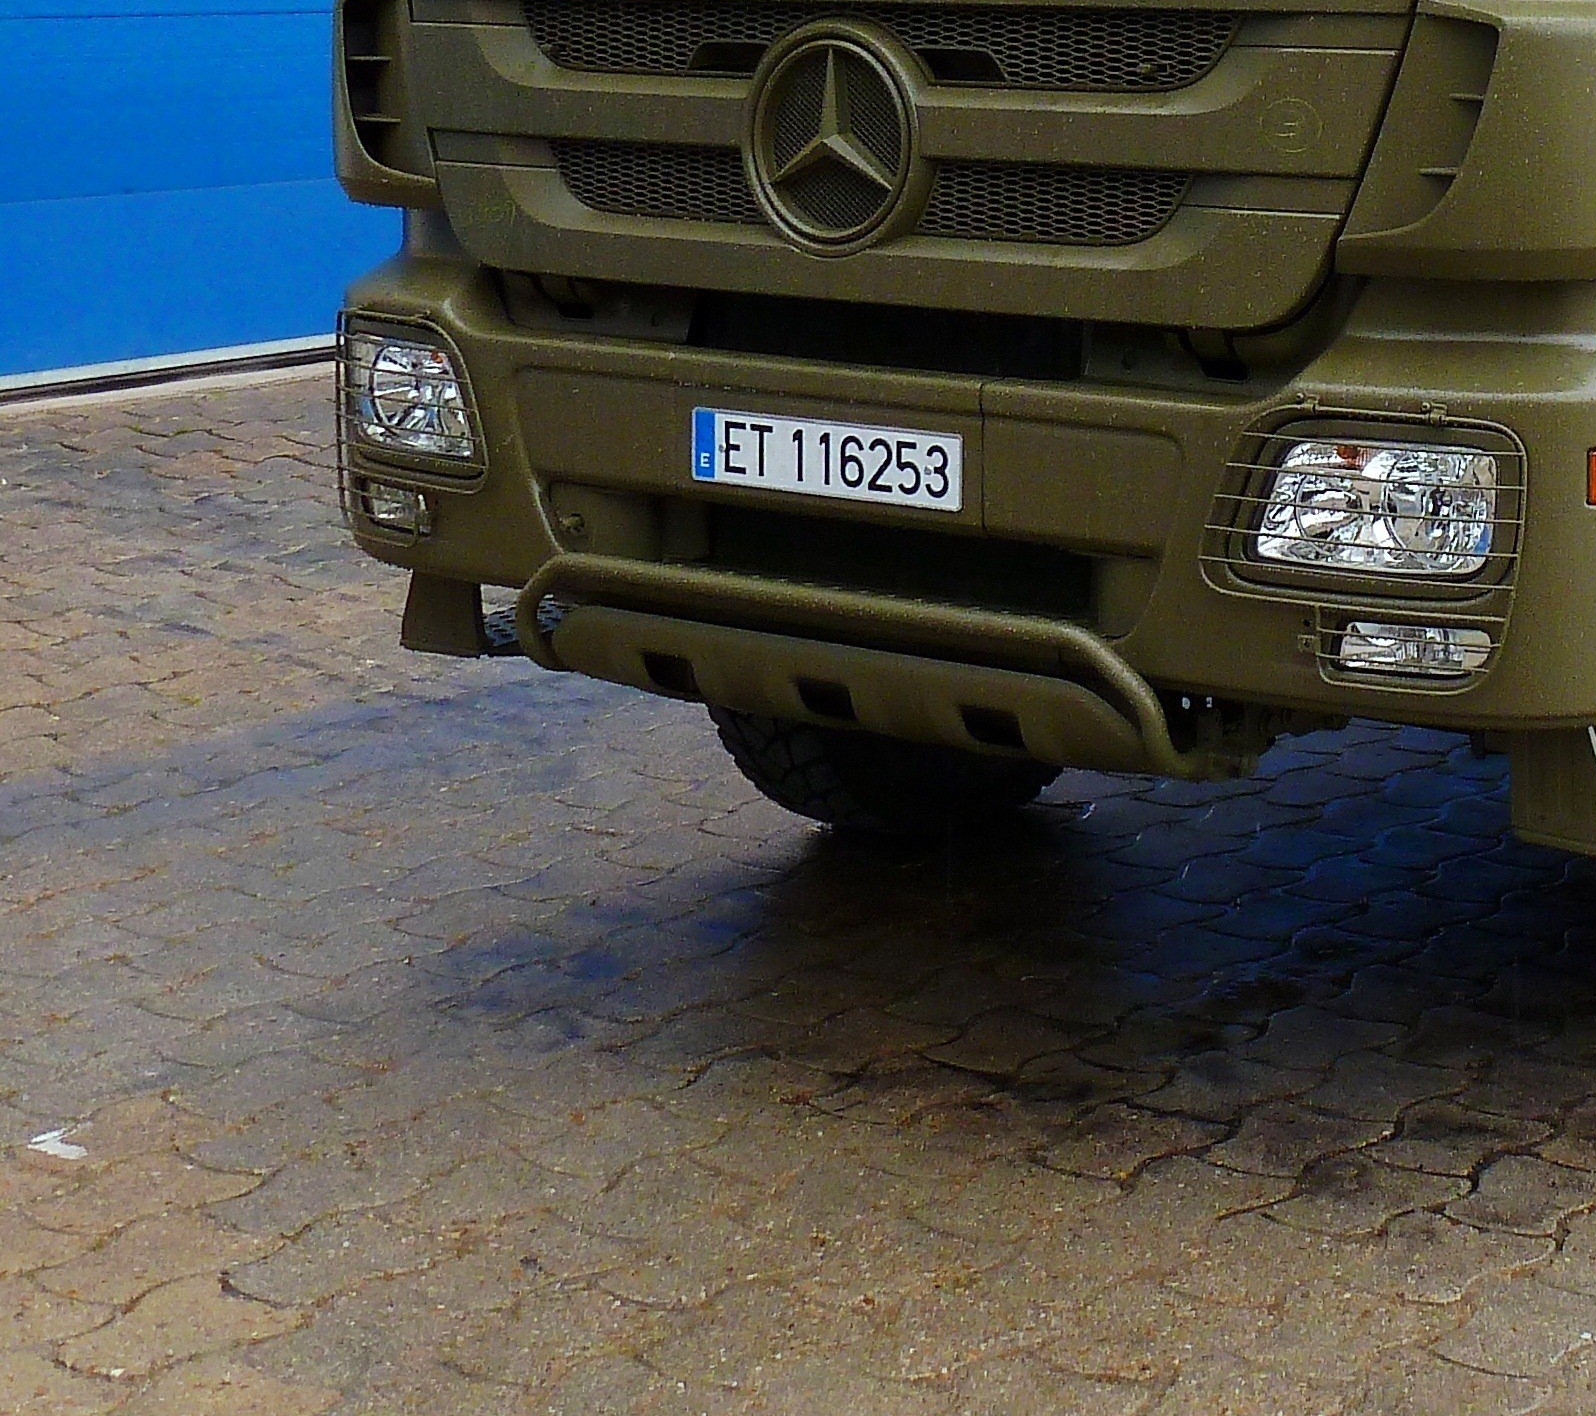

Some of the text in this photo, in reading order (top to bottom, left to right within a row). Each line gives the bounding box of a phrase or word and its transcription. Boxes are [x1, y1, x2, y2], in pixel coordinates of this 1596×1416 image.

[700, 452, 711, 468] E
[725, 420, 949, 499] ET 116253
